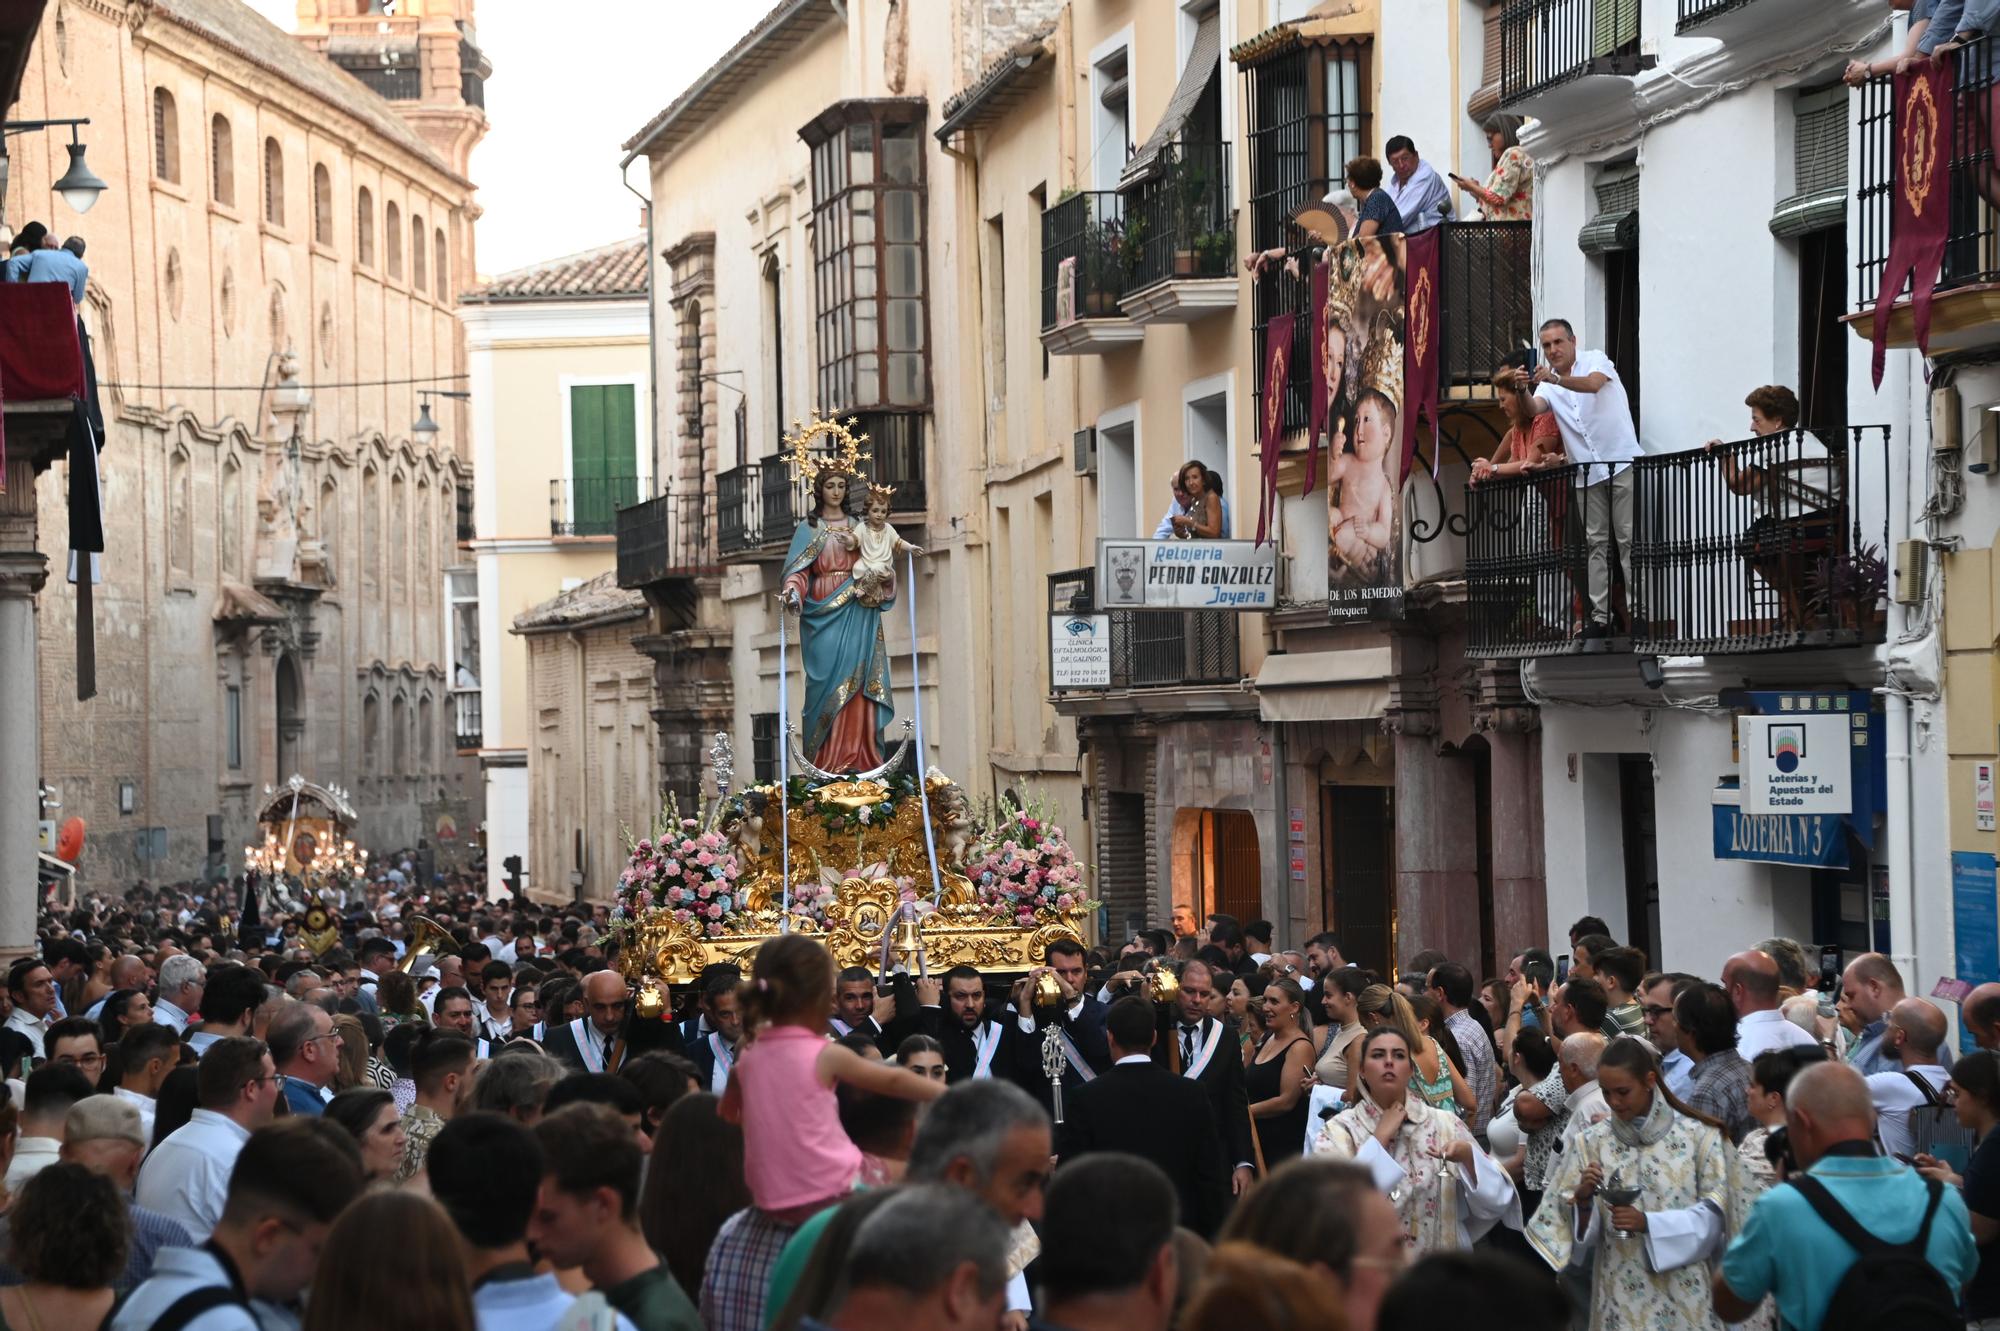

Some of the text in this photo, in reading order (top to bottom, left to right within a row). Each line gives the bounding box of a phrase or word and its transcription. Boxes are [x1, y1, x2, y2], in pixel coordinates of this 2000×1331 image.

[1148, 566, 1274, 585] PEDRO GONZALEZ
[1329, 587, 1403, 601] DE LOS REMEDIOS
[1328, 605, 1368, 617] Antequera
[1811, 775, 1818, 784] y
[1769, 784, 1833, 796] Apuestas del
[1769, 796, 1804, 806] Estado
[1731, 813, 1794, 854] LOTERIA
[1813, 816, 1822, 856] 3
